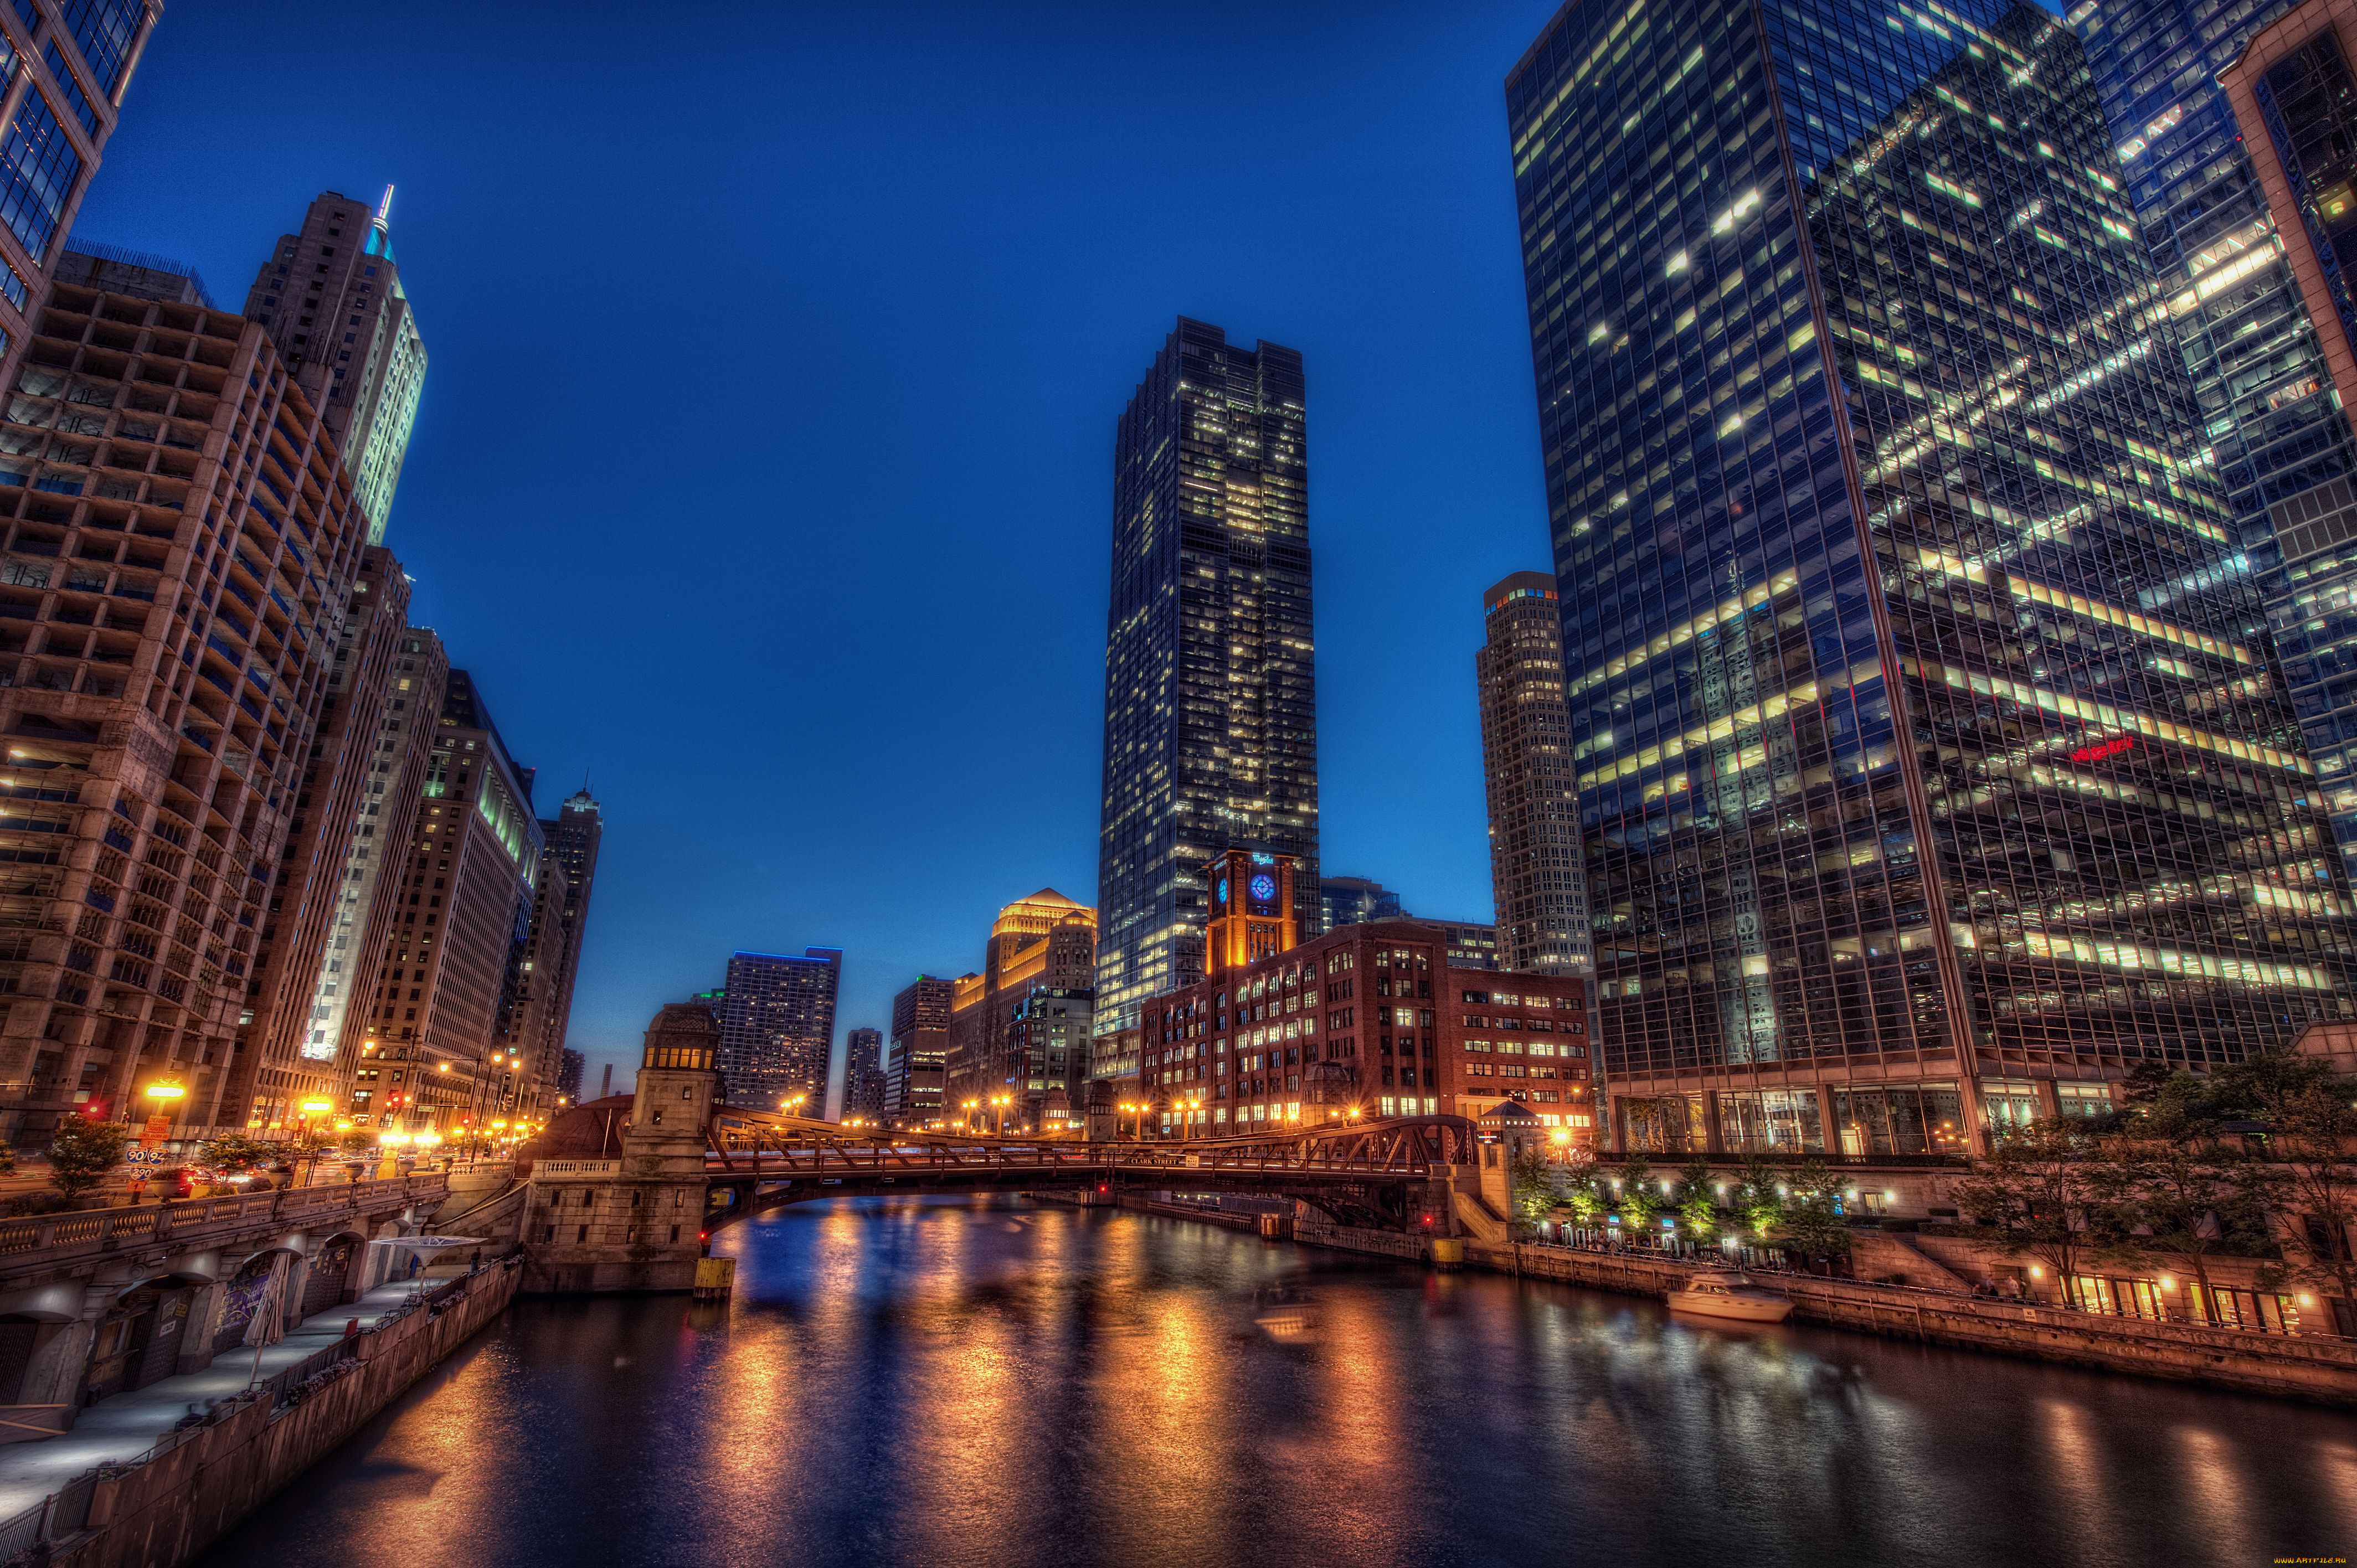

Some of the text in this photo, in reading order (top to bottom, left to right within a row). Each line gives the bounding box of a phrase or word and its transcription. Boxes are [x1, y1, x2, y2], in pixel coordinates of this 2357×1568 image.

[128, 1151, 145, 1160] 90
[150, 1152, 166, 1161] 94
[132, 1169, 151, 1179] 290
